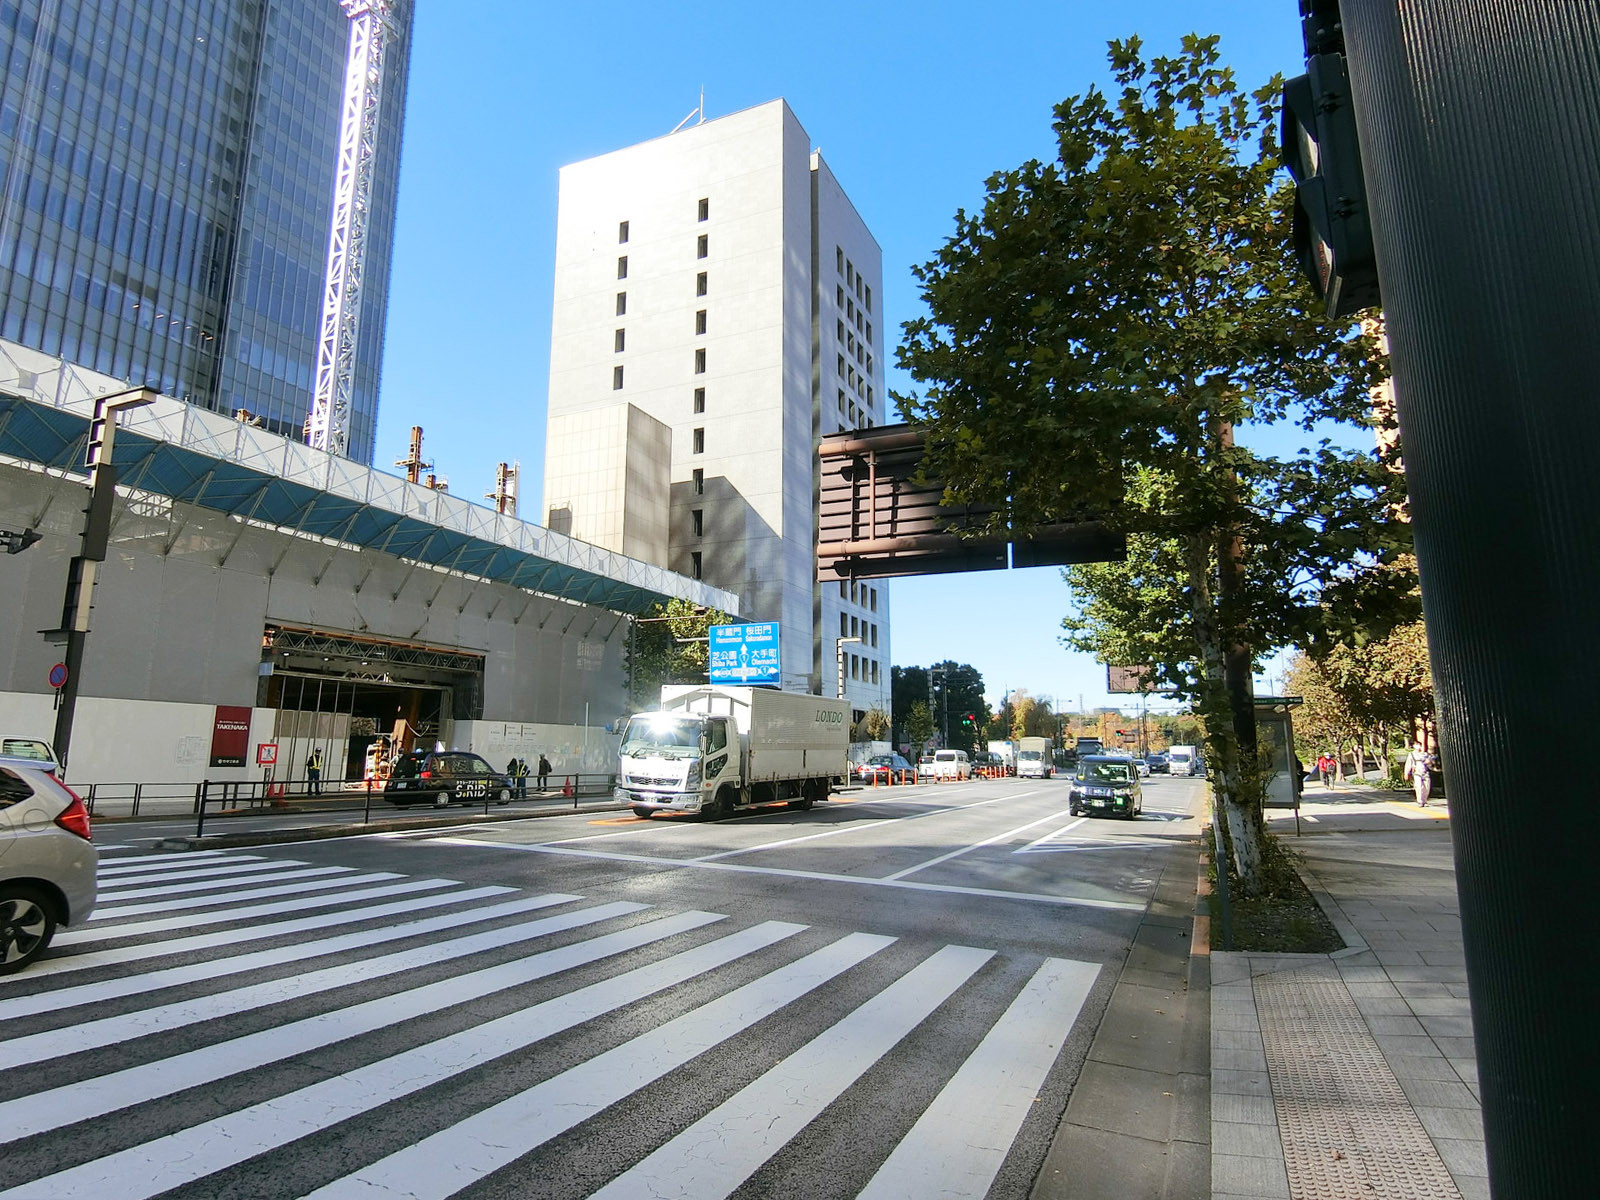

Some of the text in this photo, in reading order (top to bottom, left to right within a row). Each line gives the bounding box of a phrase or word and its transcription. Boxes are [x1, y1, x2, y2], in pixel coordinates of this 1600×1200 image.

[745, 625, 772, 635] 桜田門
[711, 650, 737, 660] 芝公園
[751, 648, 777, 659] 大手町
[726, 659, 738, 667] Park
[815, 709, 844, 723] LONDO
[216, 723, 248, 731] TAKENAKA
[455, 784, 492, 798] S.RID
